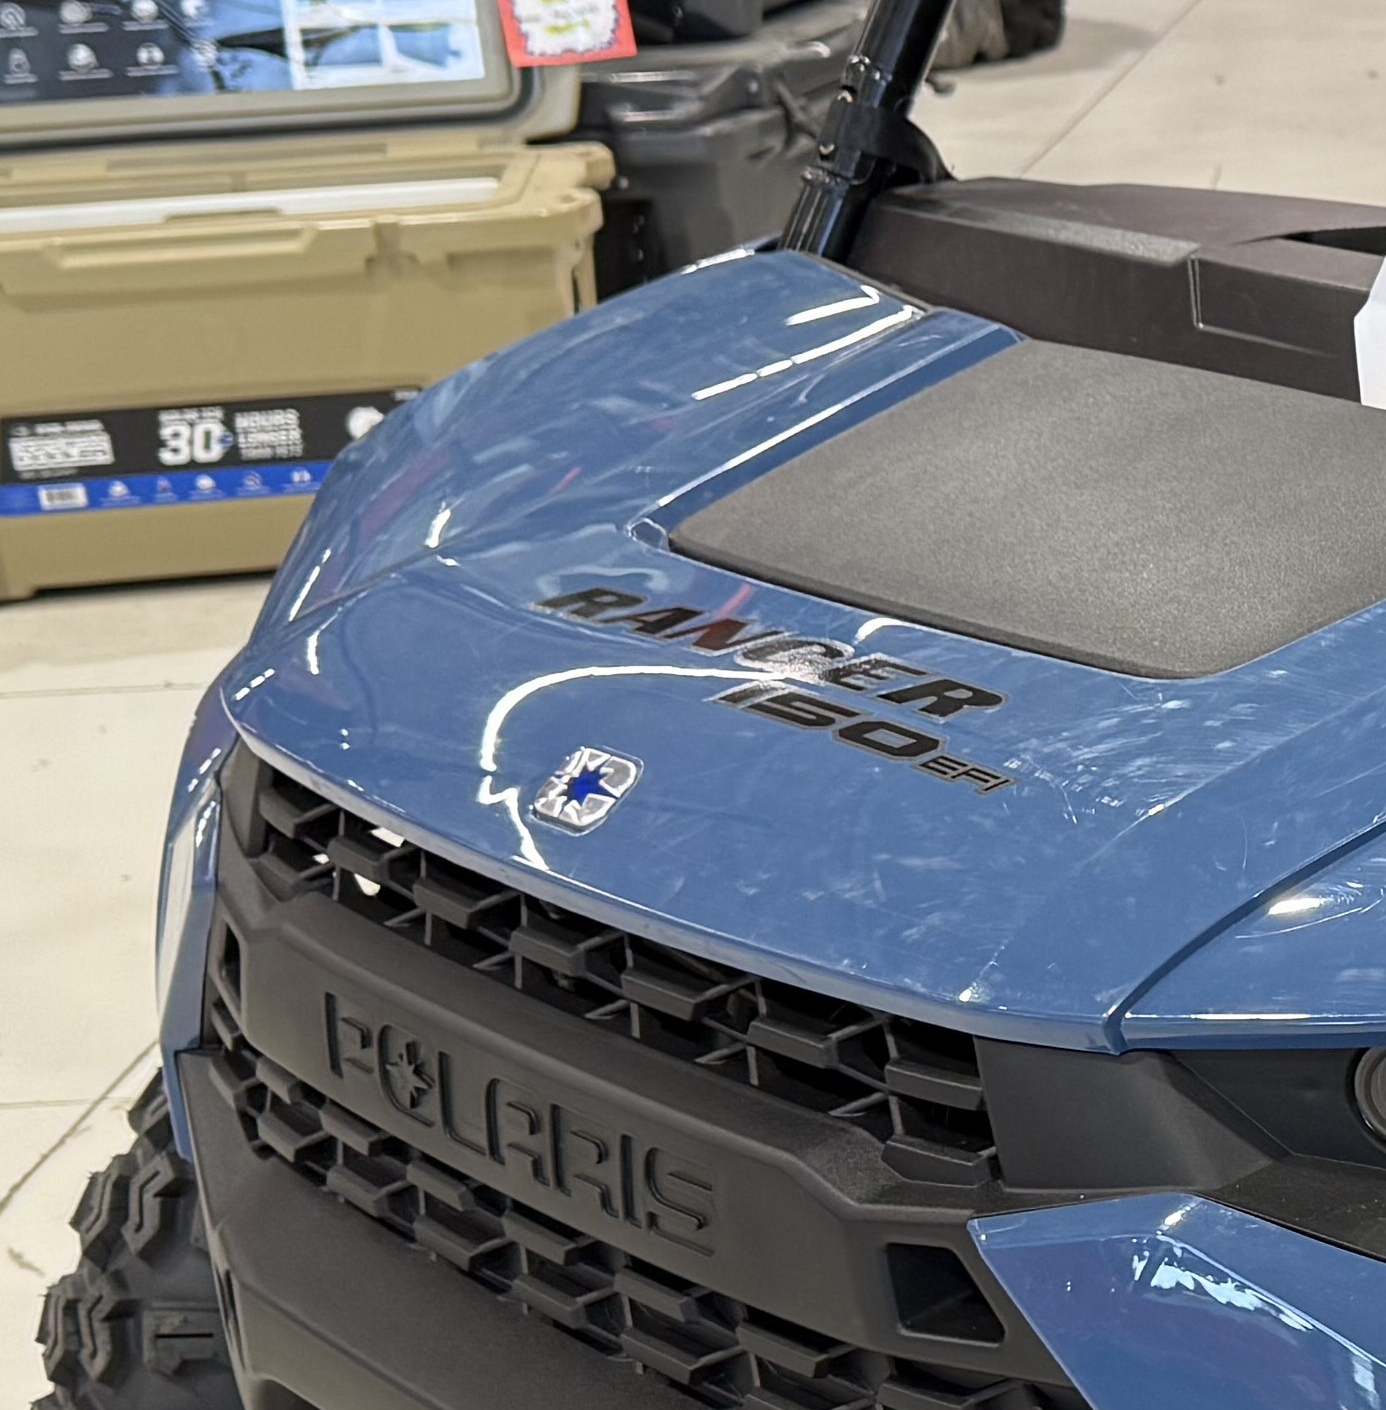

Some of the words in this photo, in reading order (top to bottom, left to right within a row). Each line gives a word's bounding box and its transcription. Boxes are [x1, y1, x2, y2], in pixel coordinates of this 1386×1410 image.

[159, 422, 224, 466] 30
[527, 587, 1008, 723] RANGER
[707, 679, 946, 759] 150
[913, 754, 1015, 795] EFI
[323, 990, 718, 1260] POLARIS
